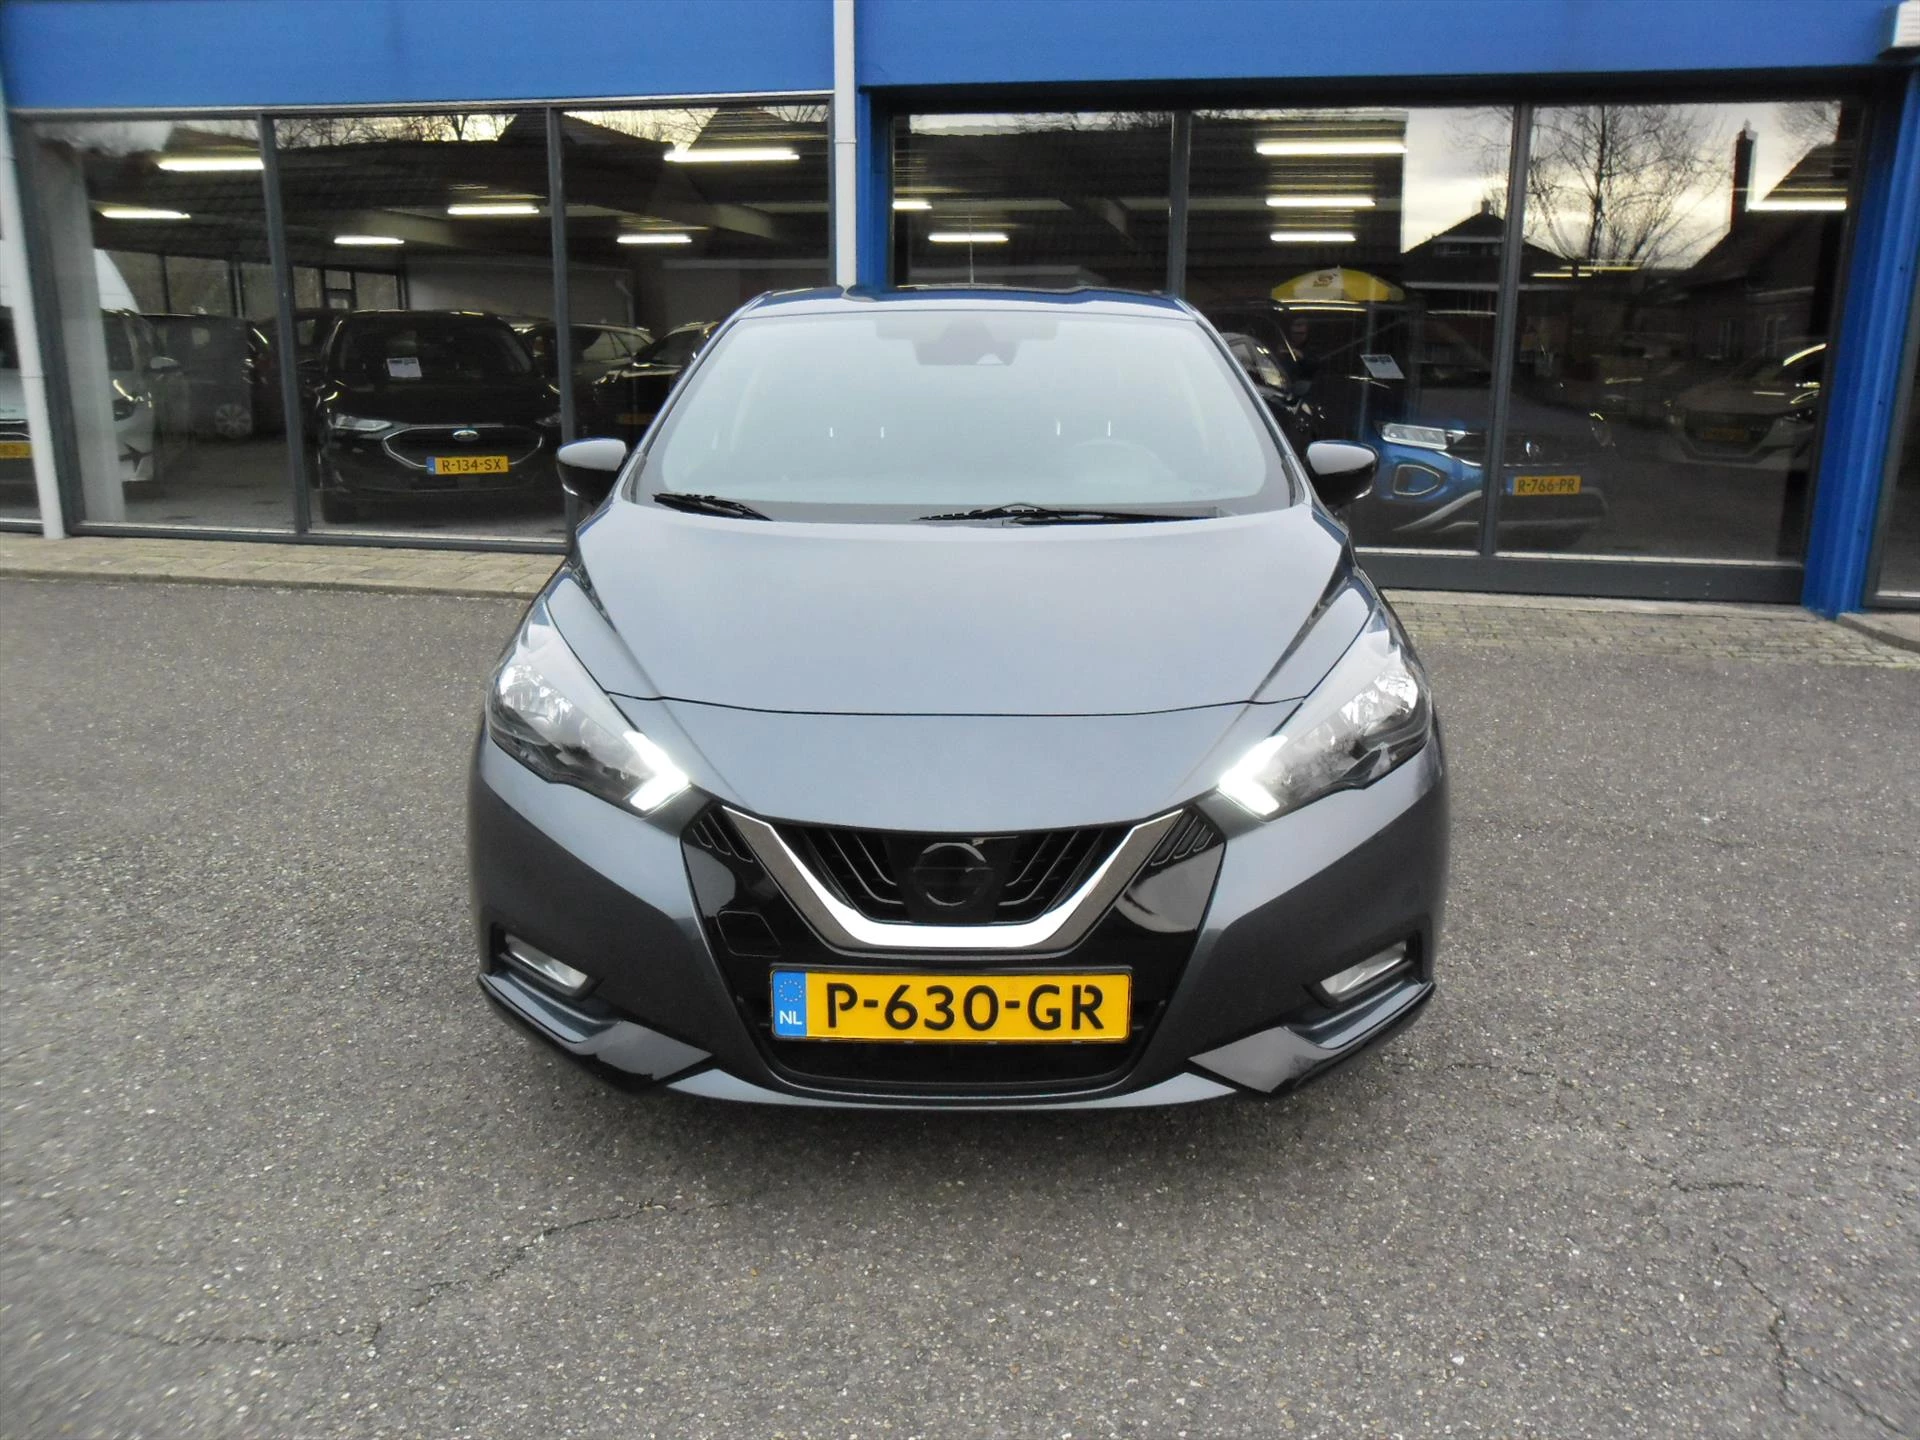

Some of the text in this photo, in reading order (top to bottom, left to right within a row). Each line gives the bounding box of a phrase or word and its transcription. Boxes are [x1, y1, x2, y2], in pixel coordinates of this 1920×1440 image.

[442, 458, 501, 472] R-134-SX
[1517, 479, 1576, 493] R-766-PR
[826, 982, 1105, 1032] P-630-GR
[779, 1009, 803, 1026] NL
